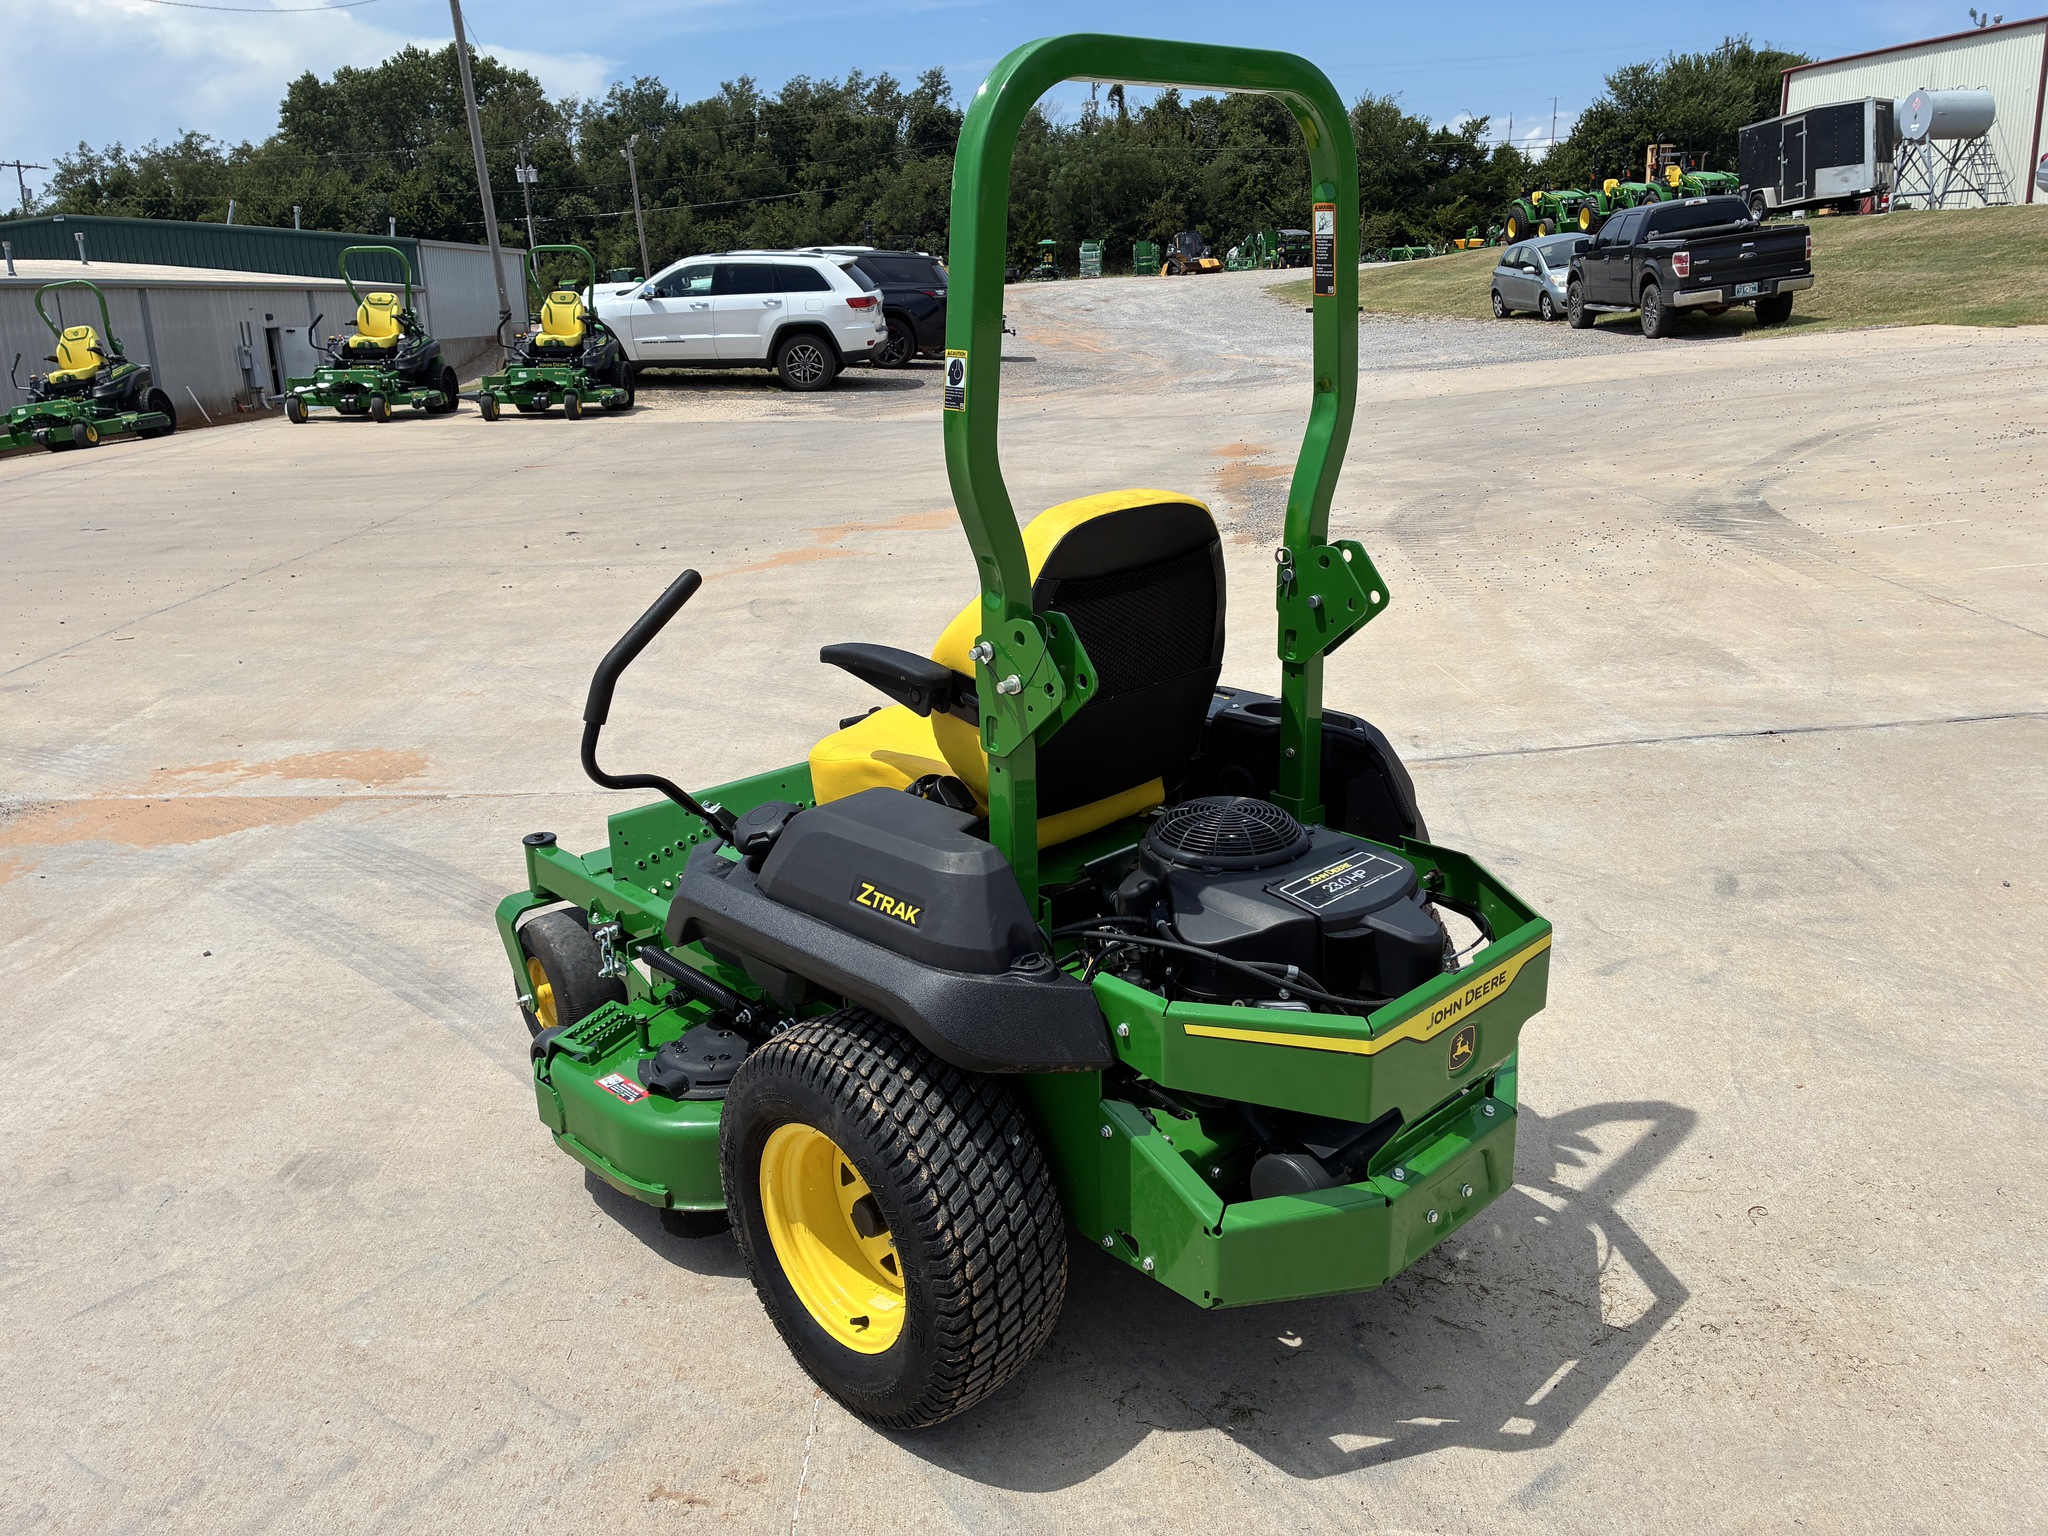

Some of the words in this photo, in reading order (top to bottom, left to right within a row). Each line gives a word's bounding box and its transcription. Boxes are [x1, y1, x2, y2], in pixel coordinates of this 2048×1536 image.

[1307, 871, 1330, 885] JOHN
[1322, 877, 1352, 893] 23.0
[1345, 869, 1366, 882] HP
[1426, 997, 1462, 1031] JOHN
[1465, 970, 1507, 1007] DEERE
